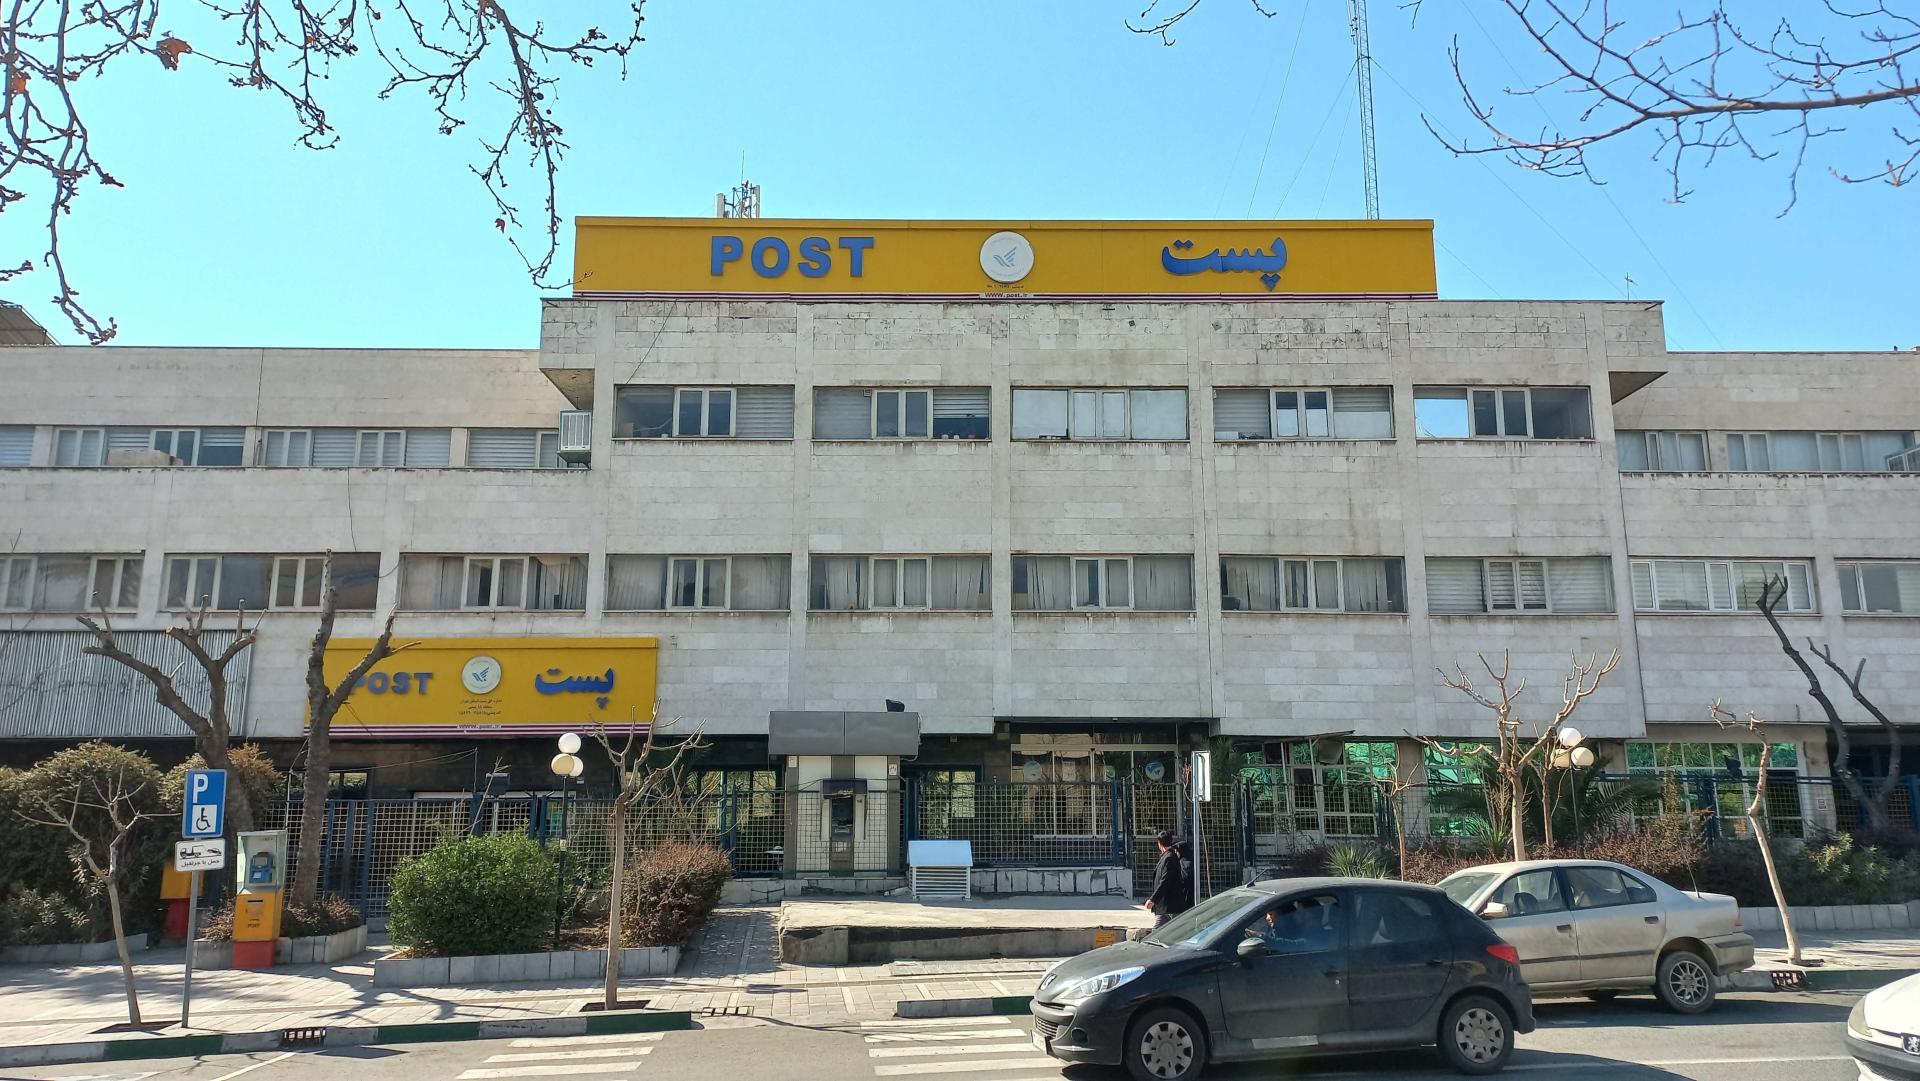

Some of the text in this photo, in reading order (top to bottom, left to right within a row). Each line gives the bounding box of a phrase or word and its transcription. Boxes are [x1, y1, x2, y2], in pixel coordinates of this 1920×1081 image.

[711, 236, 875, 277] POST
[1162, 237, 1288, 291] پست
[534, 667, 615, 709] پست
[192, 773, 209, 804] P
